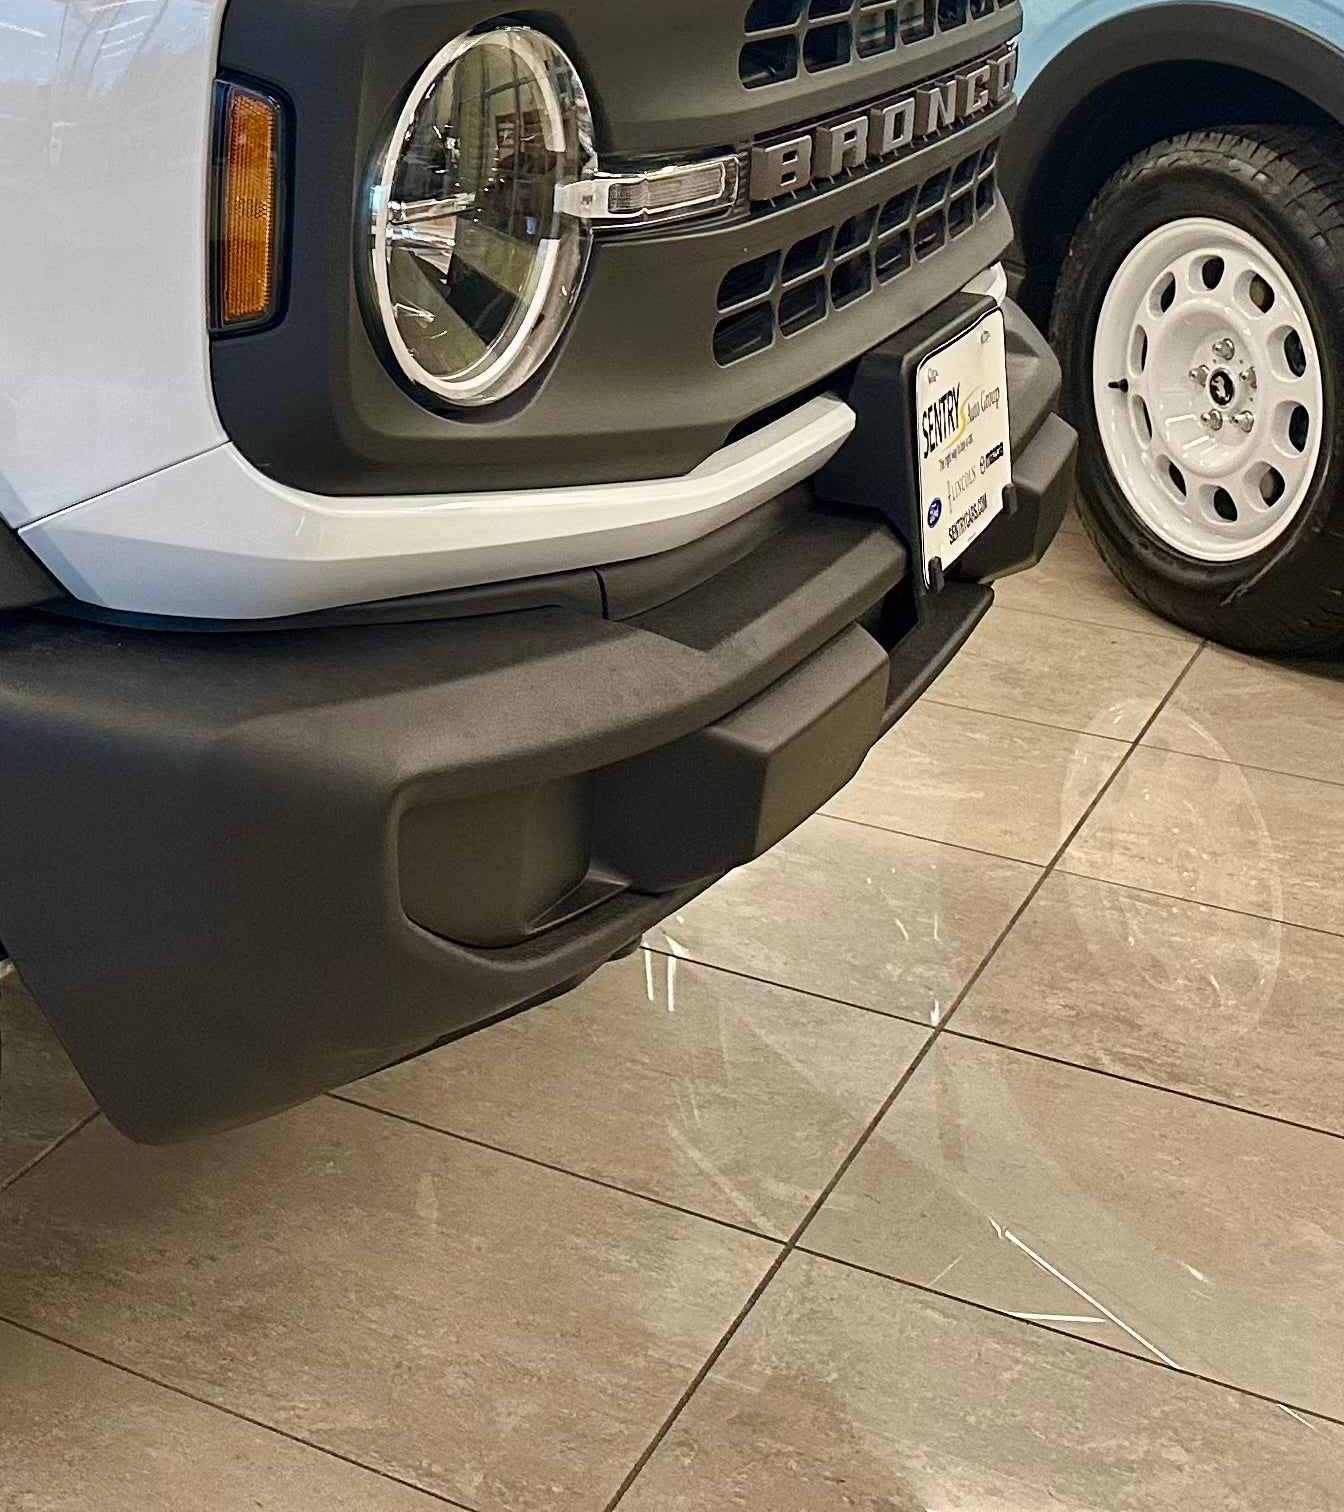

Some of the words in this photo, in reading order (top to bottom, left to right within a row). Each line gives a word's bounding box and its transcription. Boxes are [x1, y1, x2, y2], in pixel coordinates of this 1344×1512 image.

[750, 48, 1017, 201] BRONCO
[922, 382, 960, 459] SENTRY
[980, 387, 1000, 412] Group
[948, 493, 988, 545] SENTRYCARS.COM
